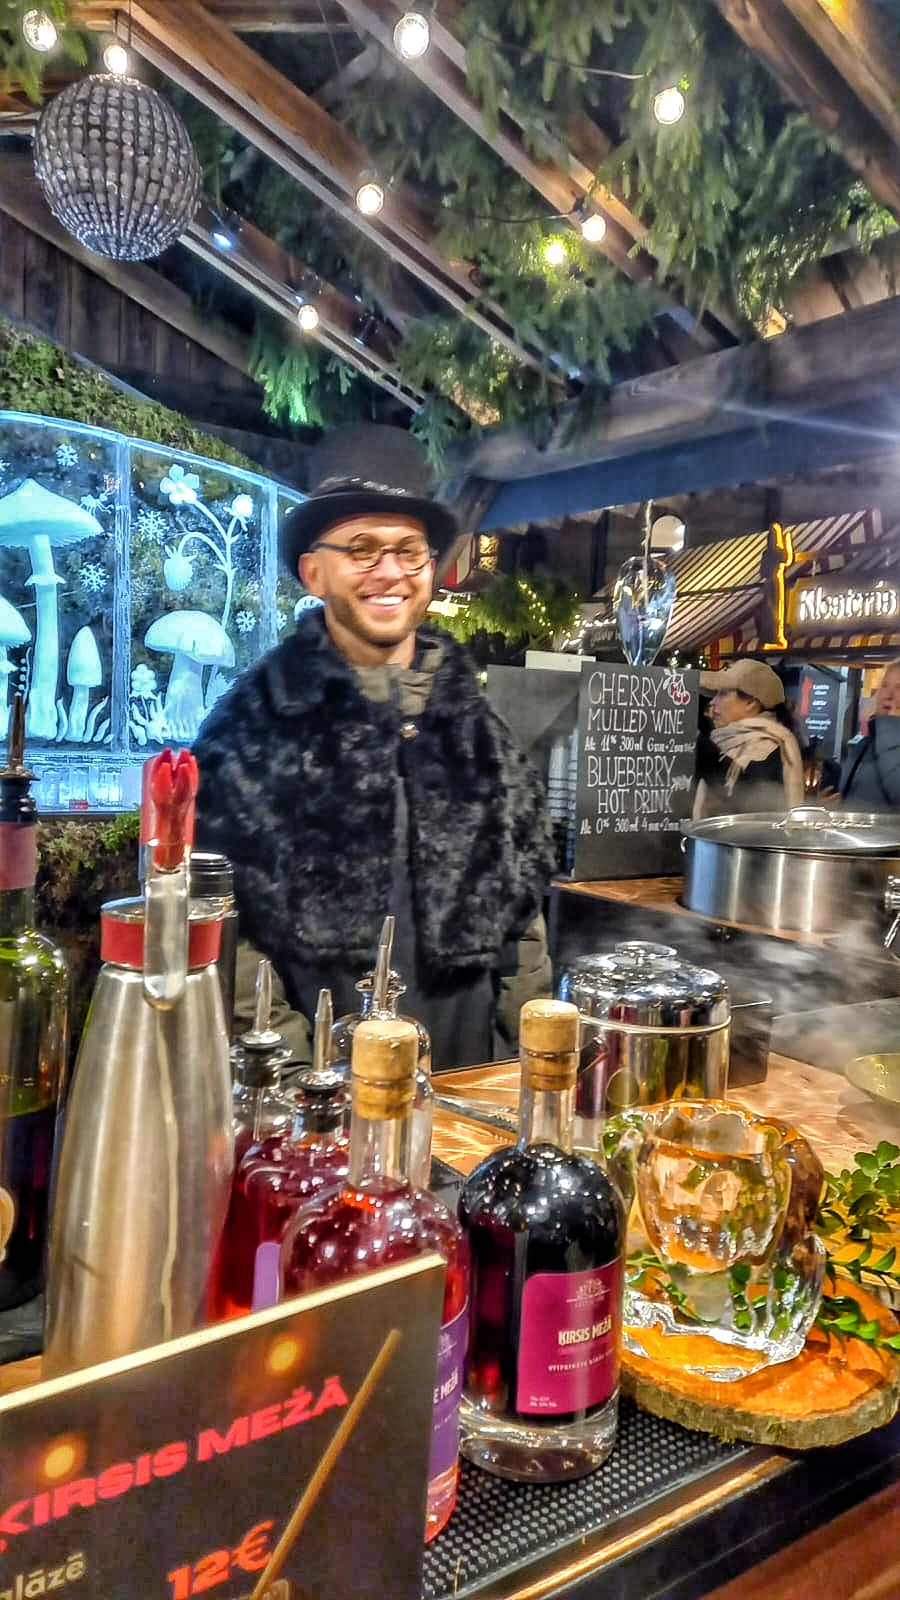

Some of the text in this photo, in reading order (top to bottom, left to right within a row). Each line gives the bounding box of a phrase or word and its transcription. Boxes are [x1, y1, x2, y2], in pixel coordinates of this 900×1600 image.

[588, 671, 664, 707] CHERRY
[586, 708, 686, 734] MULLED WINE
[587, 755, 677, 788] BLUEBERRY
[597, 788, 673, 814] HOT DRINK
[196, 1375, 349, 1461] MEŽĀ
[167, 1519, 274, 1600] 12€
